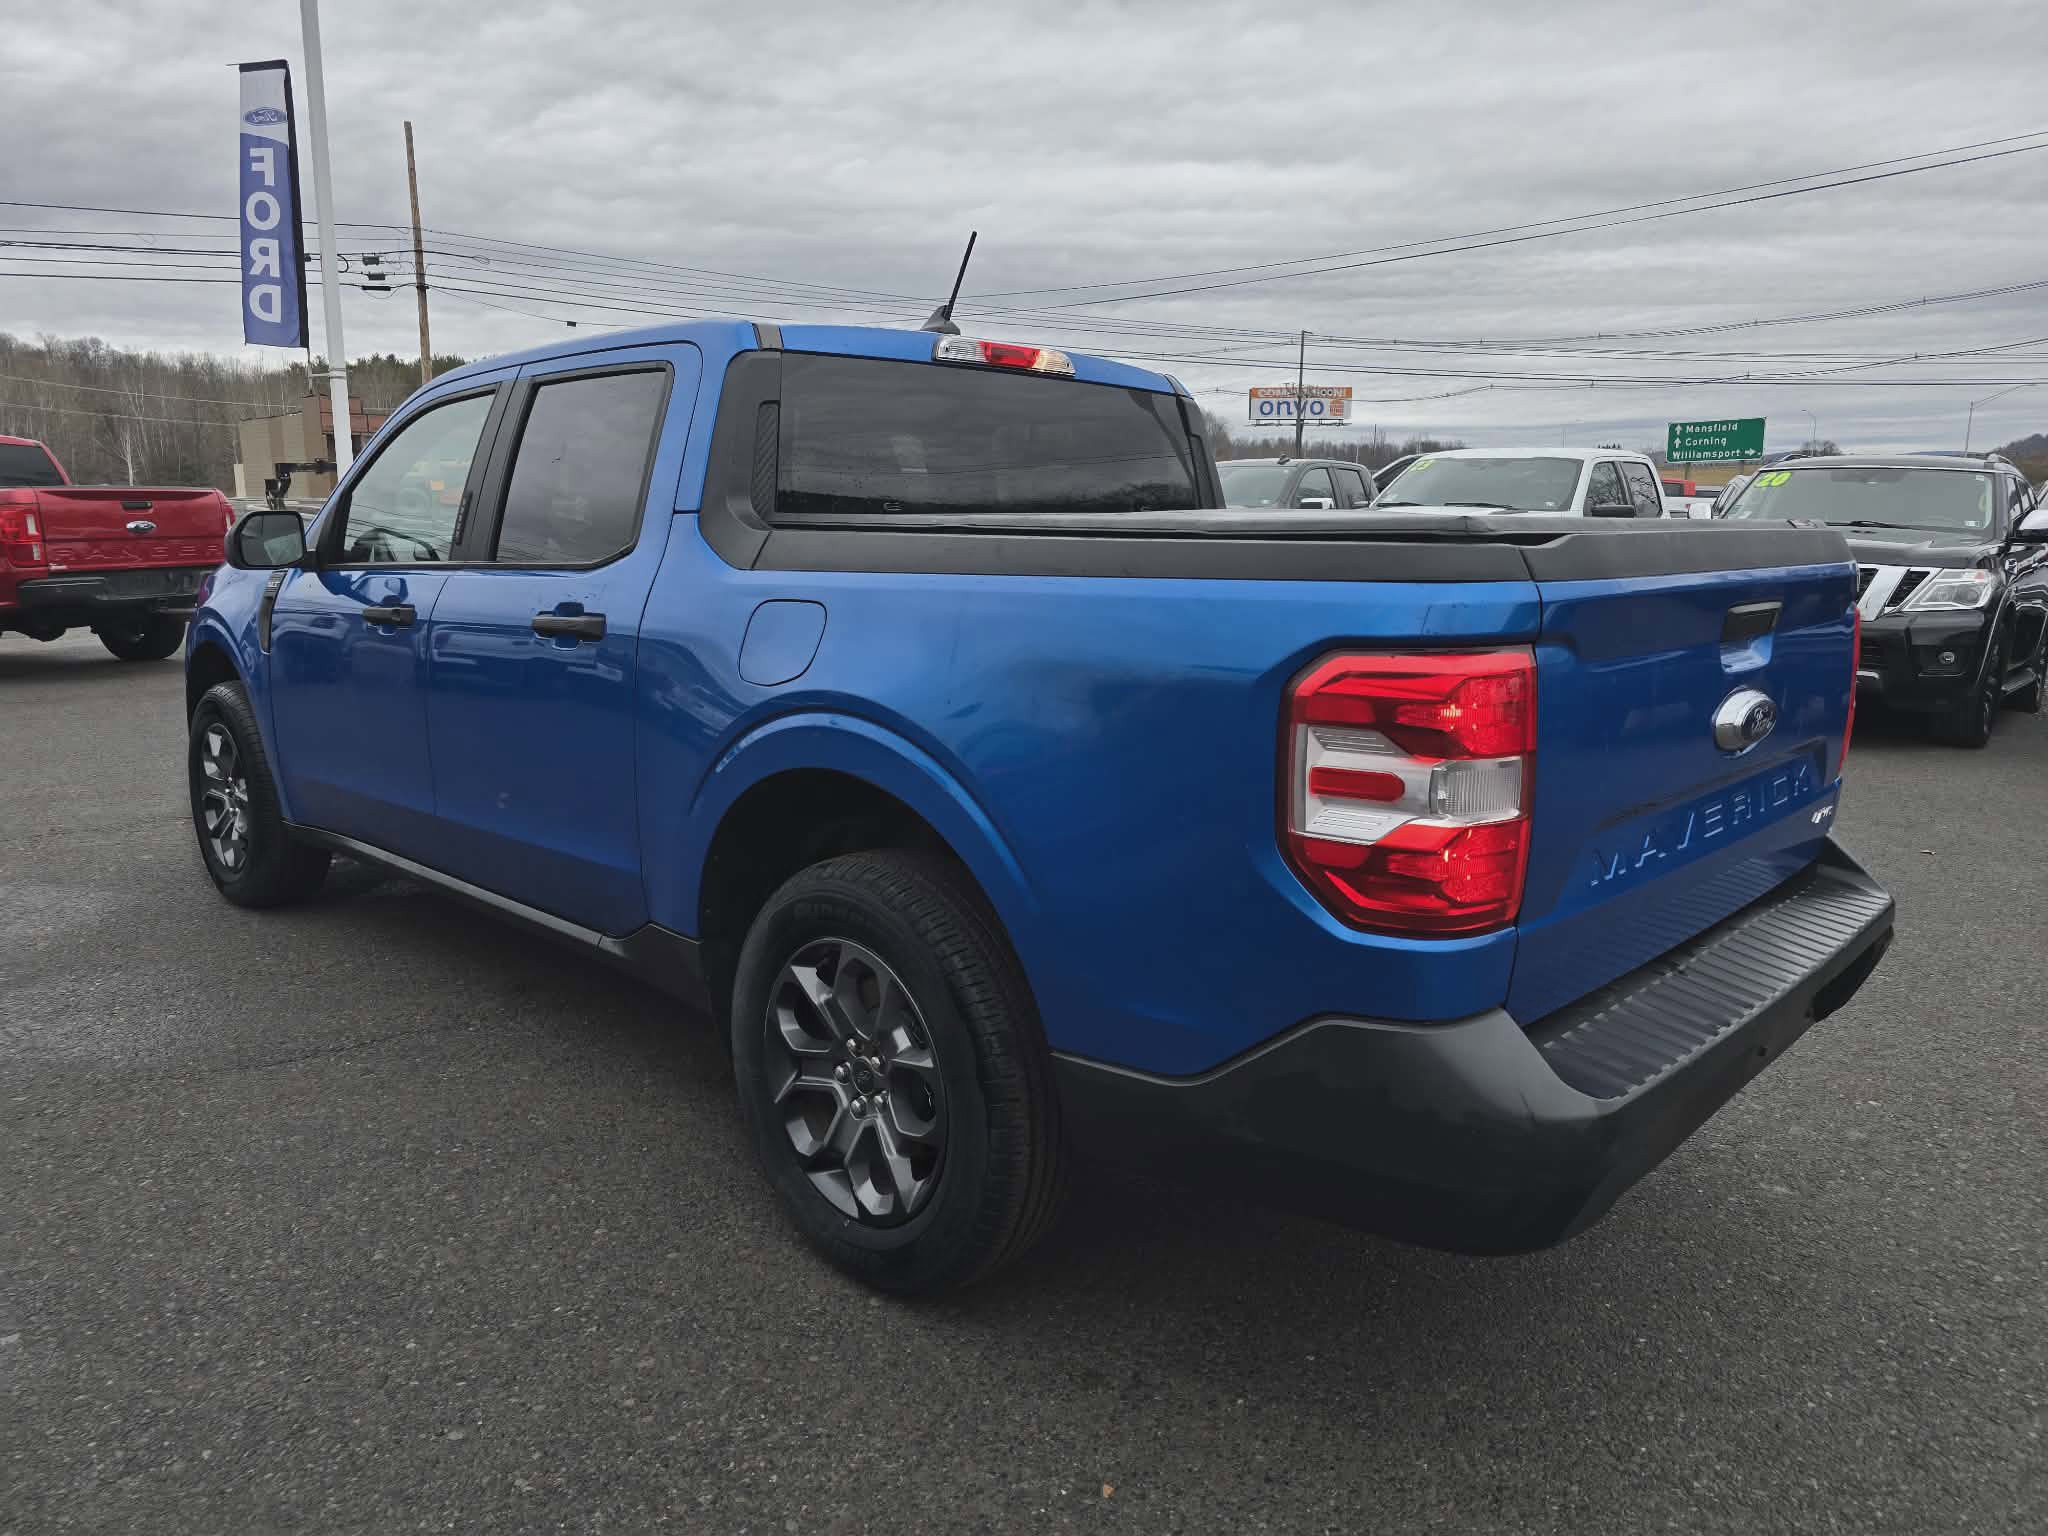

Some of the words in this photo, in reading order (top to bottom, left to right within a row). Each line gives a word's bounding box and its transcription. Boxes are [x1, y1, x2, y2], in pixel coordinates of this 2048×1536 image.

[1686, 423, 1738, 433] Mansfield
[1685, 437, 1727, 447] Corning
[1672, 449, 1741, 460] Williamsport
[1590, 764, 1810, 887] MAVERICK
